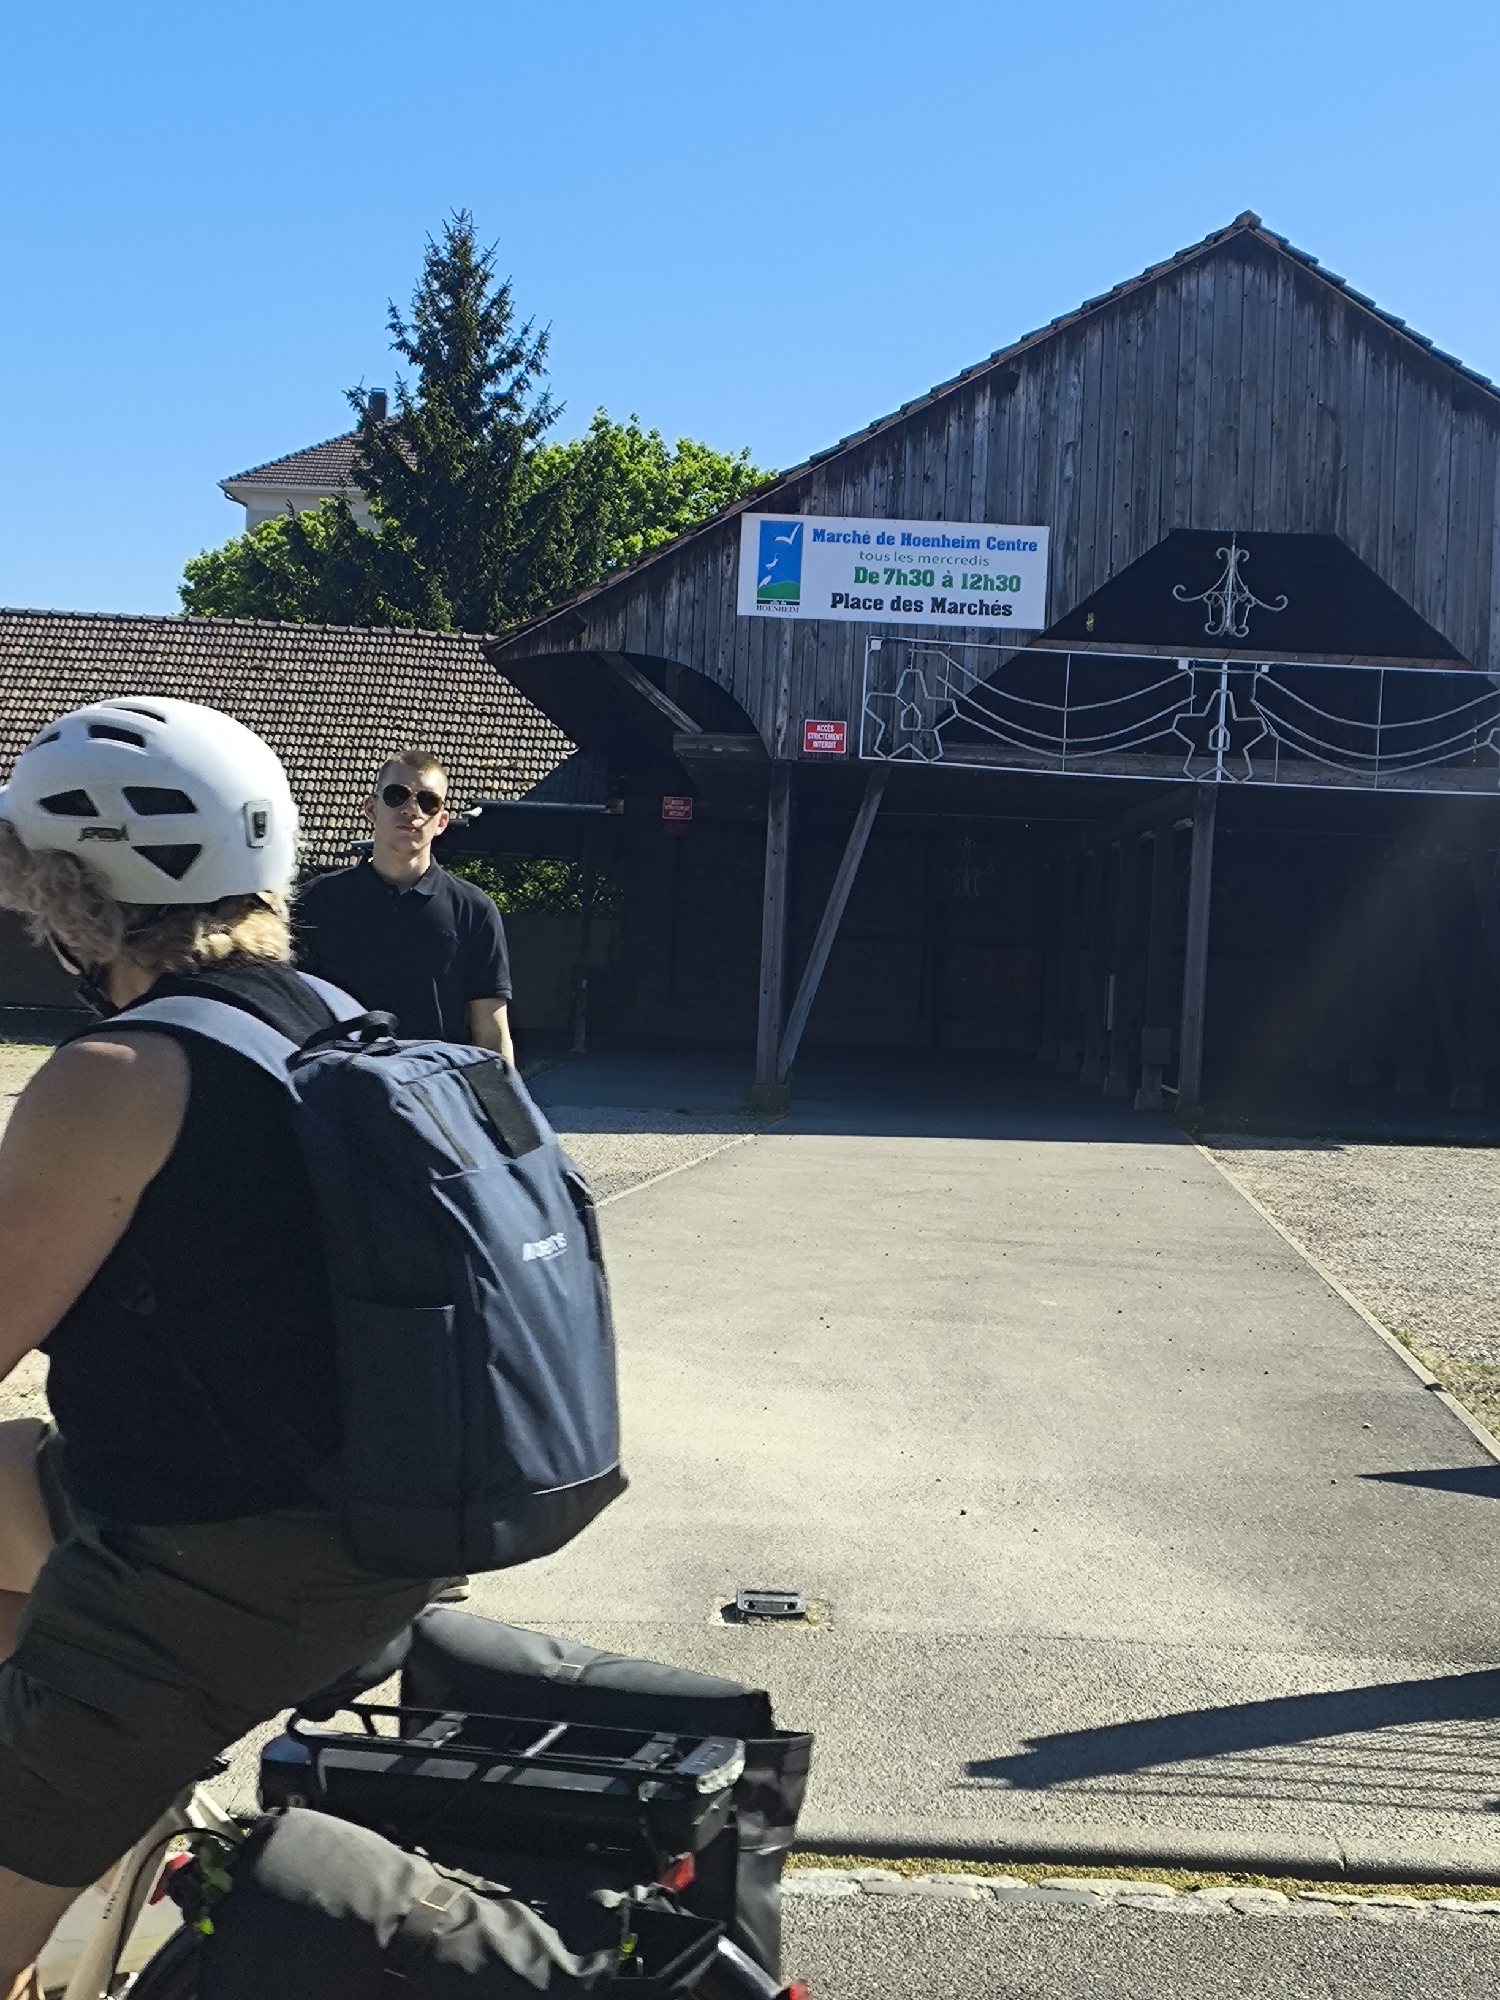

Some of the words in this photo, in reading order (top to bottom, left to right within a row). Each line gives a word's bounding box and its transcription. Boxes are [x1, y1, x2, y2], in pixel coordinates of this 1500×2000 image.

[812, 528, 871, 545] Marché
[876, 532, 896, 546] de
[901, 532, 980, 549] Hoenheim
[986, 536, 1038, 552] Centre
[859, 551, 890, 562] tous
[894, 550, 913, 563] les
[918, 554, 990, 565] mercredis
[854, 567, 880, 584] De
[884, 567, 935, 587] 7h30
[942, 570, 954, 588] à
[961, 573, 1021, 592] 12h30
[756, 604, 799, 613] HOENHEIM
[831, 593, 884, 611] Place
[891, 596, 924, 612] des
[931, 597, 1013, 617] Marchés
[807, 733, 843, 741] STRICTEMENT
